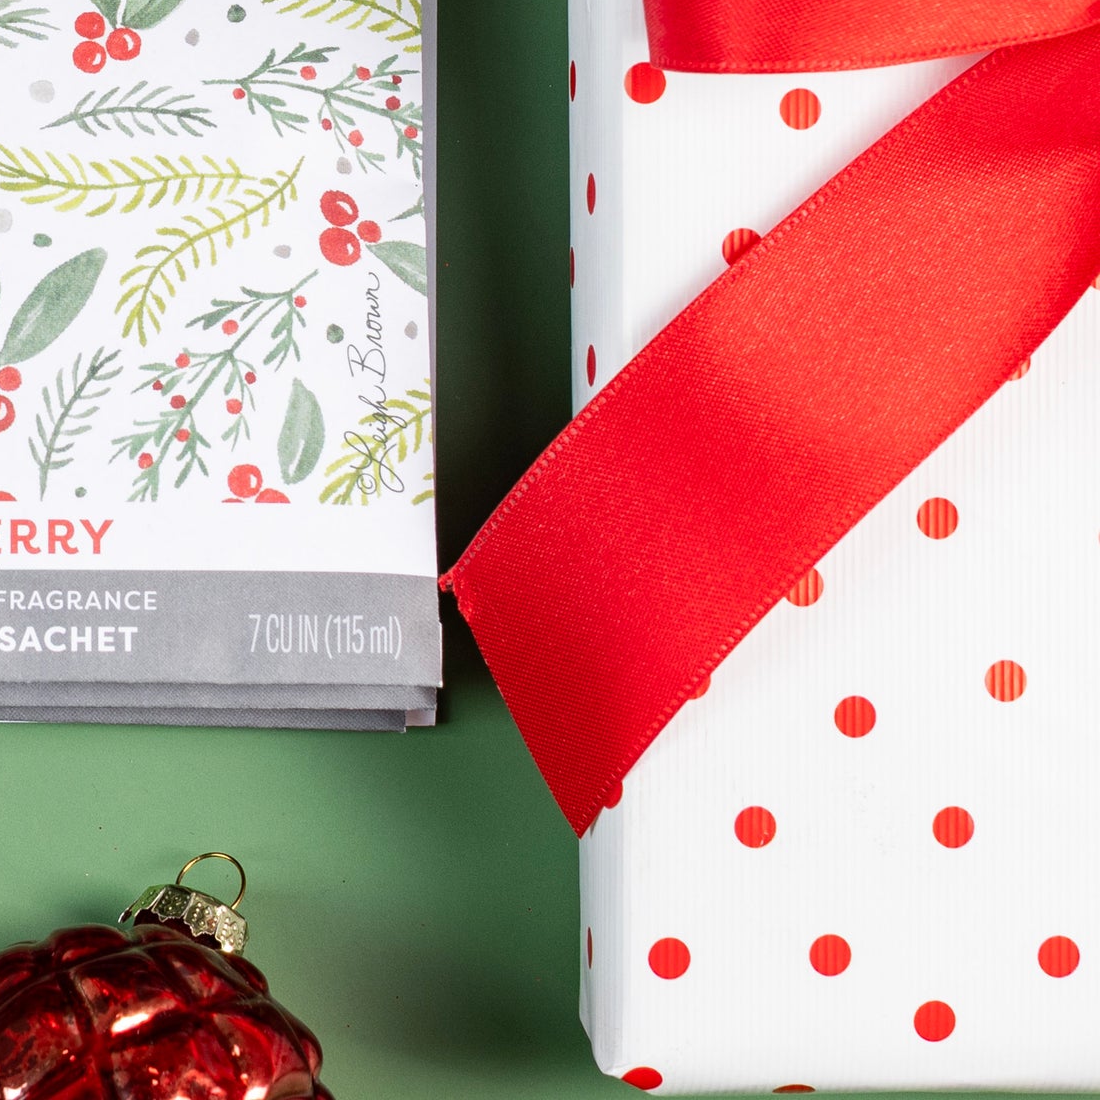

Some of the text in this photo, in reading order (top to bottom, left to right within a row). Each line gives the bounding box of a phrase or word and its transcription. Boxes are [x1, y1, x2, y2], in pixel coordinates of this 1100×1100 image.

[347, 272, 386, 384] Brown
[247, 613, 402, 660] 7 CU IN (115 ml)
